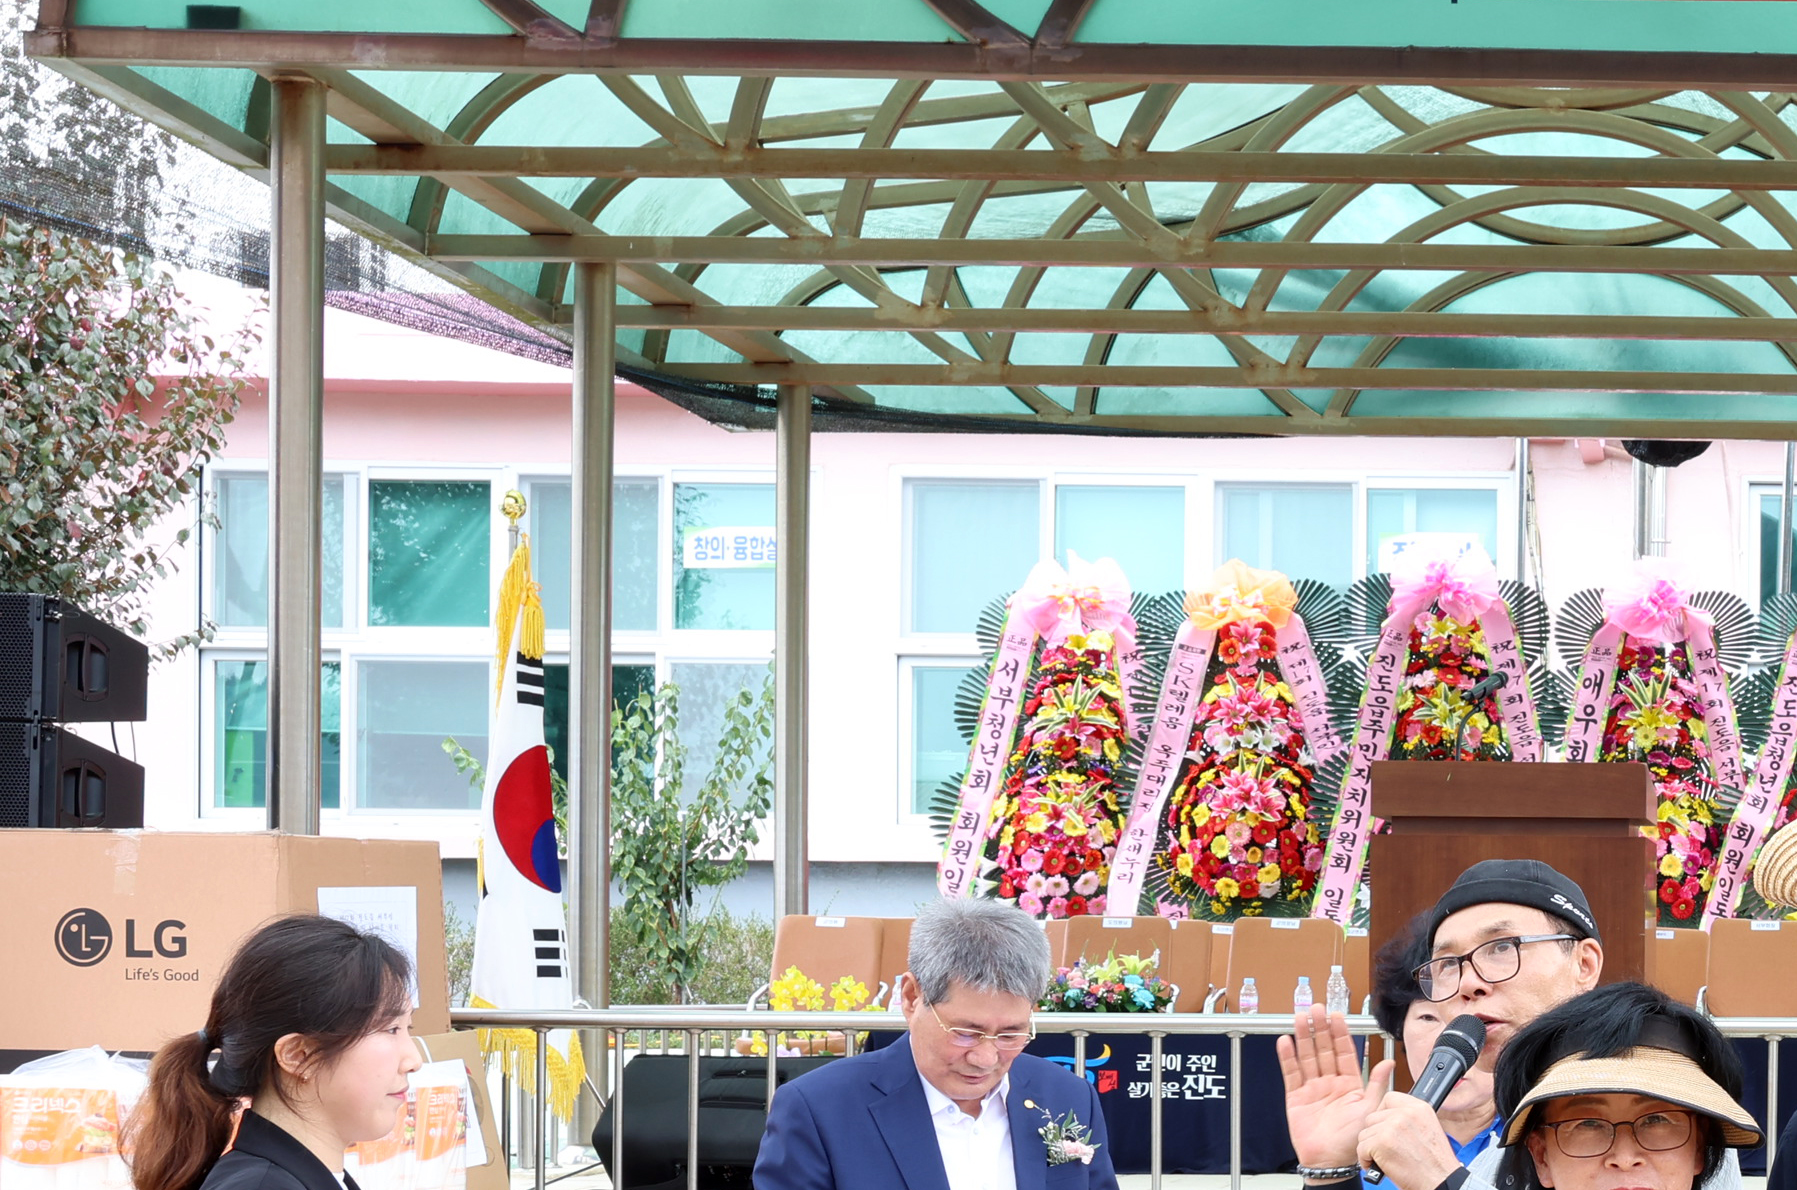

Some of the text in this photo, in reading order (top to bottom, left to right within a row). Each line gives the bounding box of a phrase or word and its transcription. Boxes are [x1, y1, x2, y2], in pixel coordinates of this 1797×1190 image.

[1491, 640, 1516, 654] 祝
[1695, 648, 1717, 661] 祝
[1566, 669, 1605, 763] 애우회
[944, 658, 1020, 897] 서부청년회 회원일
[1718, 757, 1741, 792] 서부
[125, 920, 187, 959] LG
[125, 967, 199, 982] Life's Good
[1186, 1054, 1217, 1072] 주인
[1181, 1074, 1226, 1100] 진도
[12, 1097, 81, 1113] 크리넥스
